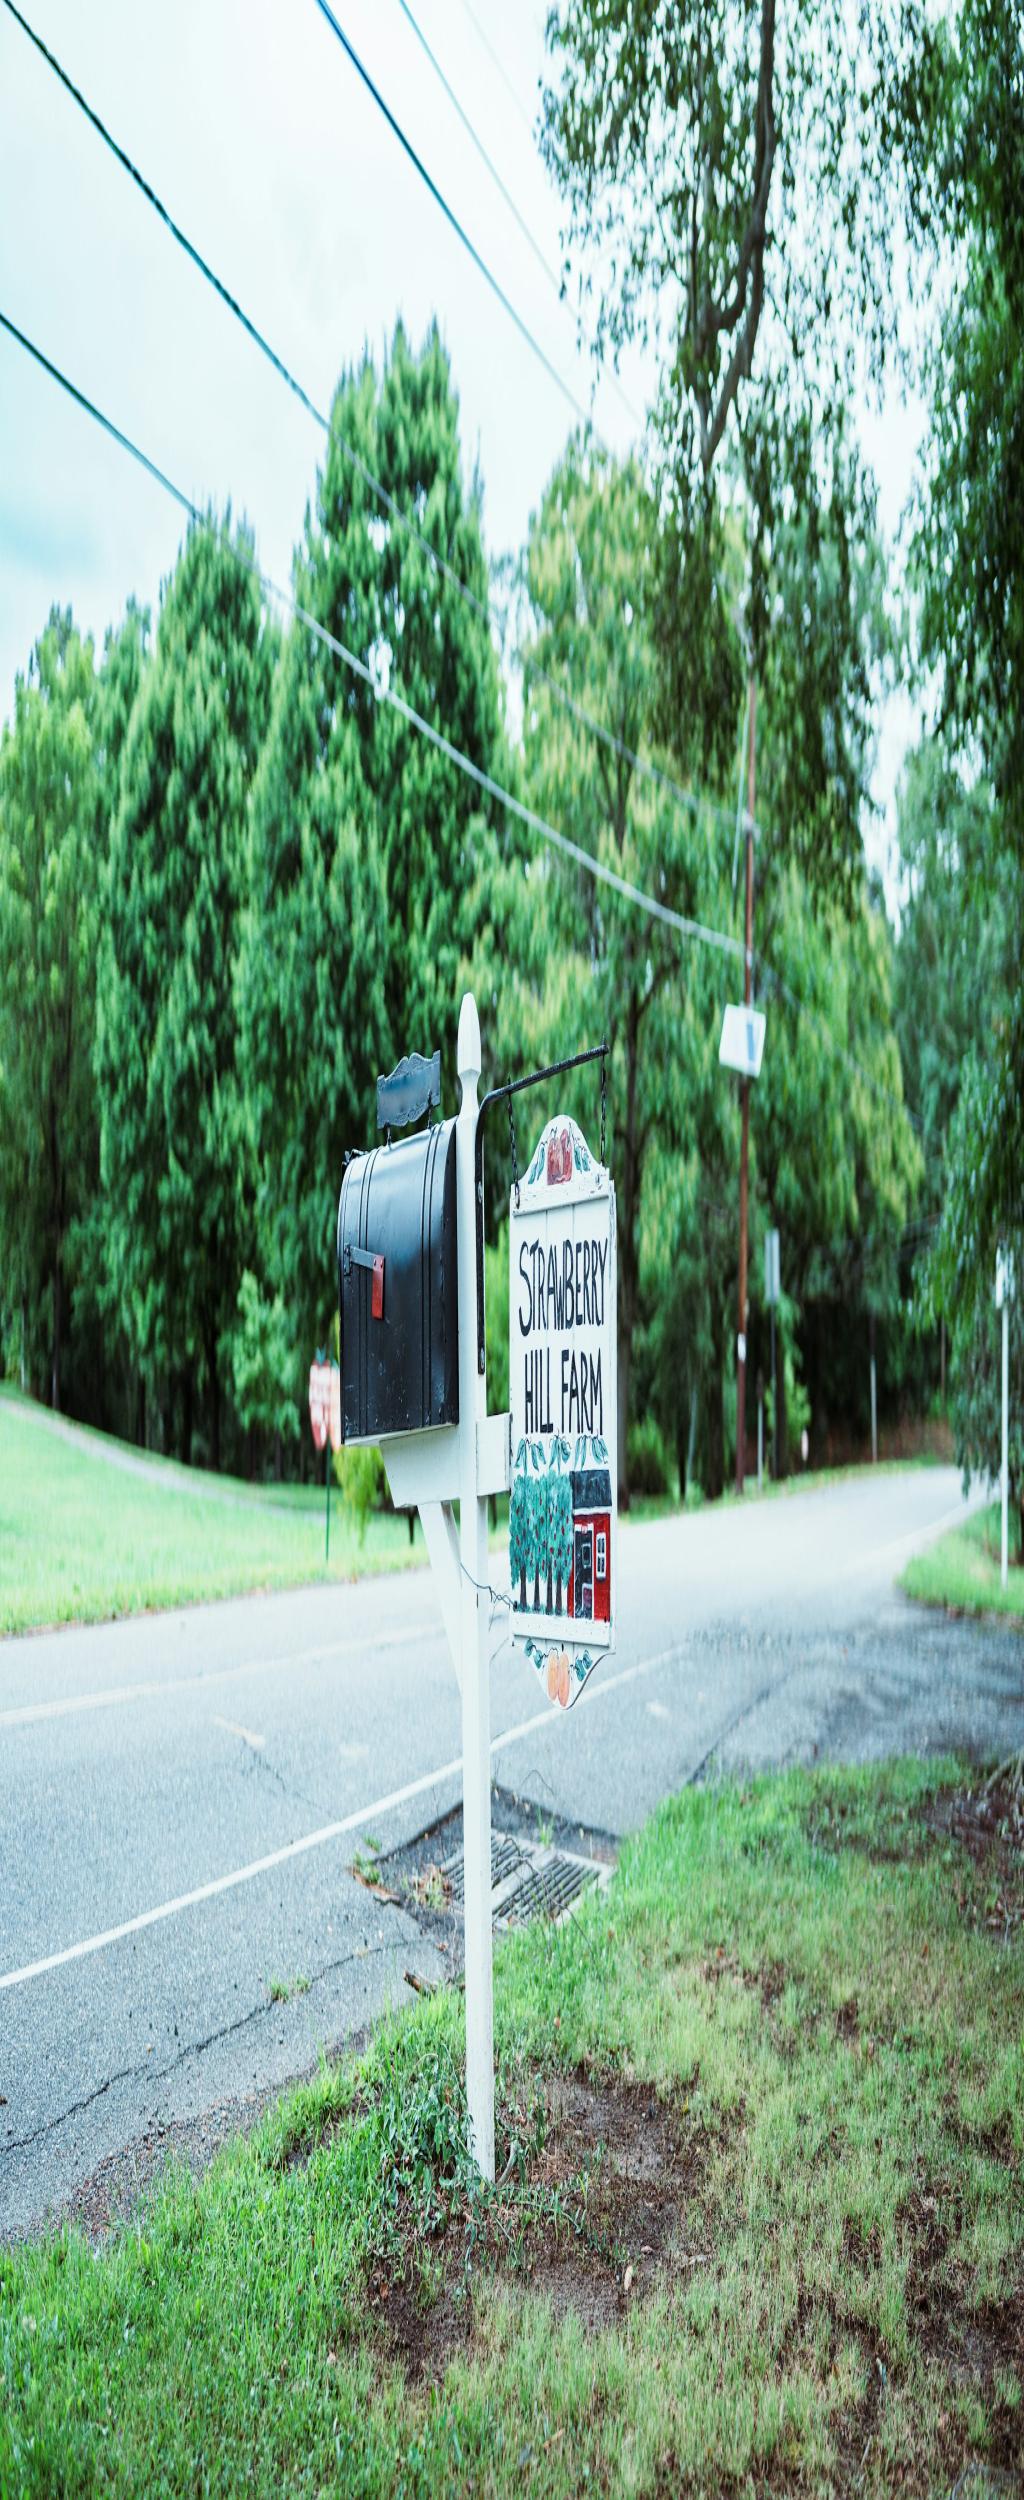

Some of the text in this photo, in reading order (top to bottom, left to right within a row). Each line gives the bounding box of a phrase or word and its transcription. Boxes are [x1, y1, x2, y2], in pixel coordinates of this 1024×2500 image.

[519, 1238, 608, 1336] STRAWBERRY
[525, 1347, 603, 1435] HILL FARM
